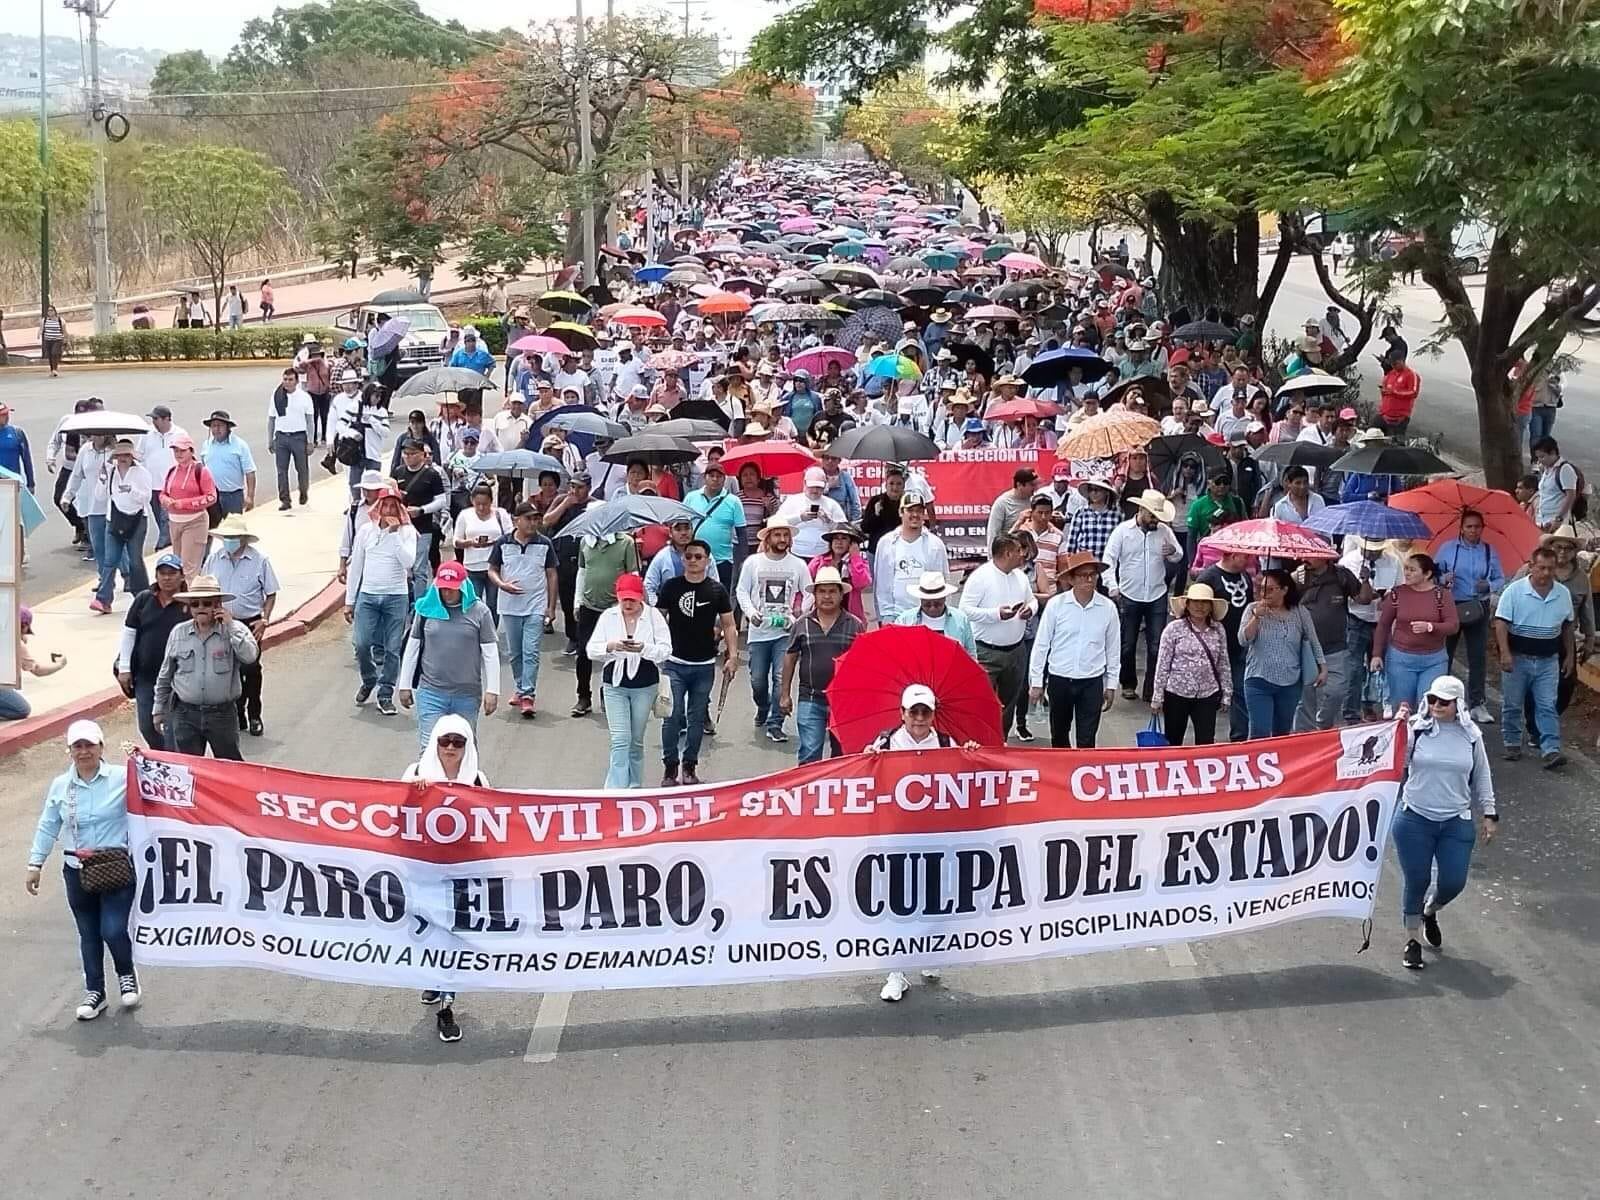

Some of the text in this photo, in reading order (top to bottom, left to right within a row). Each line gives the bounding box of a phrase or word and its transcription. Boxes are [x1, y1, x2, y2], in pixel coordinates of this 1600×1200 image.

[1019, 449, 1039, 462] VII
[934, 504, 992, 515] ONGRES
[944, 527, 966, 537] NO
[256, 751, 1285, 844] SECCIÓN VII DEL SNTE-CNTE CHIAPAS
[140, 799, 1381, 935] ¡EL PARO, EL PARO, ES CULPA DEL ESTADO!
[135, 925, 256, 948] EXIGIMOS
[261, 933, 391, 964] SOLUCIÓN
[395, 946, 413, 967] A
[420, 948, 558, 973] NUESTRAS
[564, 945, 715, 970] DEMANDAS!
[728, 940, 828, 963] UNIDOS,
[836, 928, 1013, 959] ORGANIZADOS
[1019, 925, 1033, 945] Y
[1039, 904, 1219, 942] DISCIPLINADOS,
